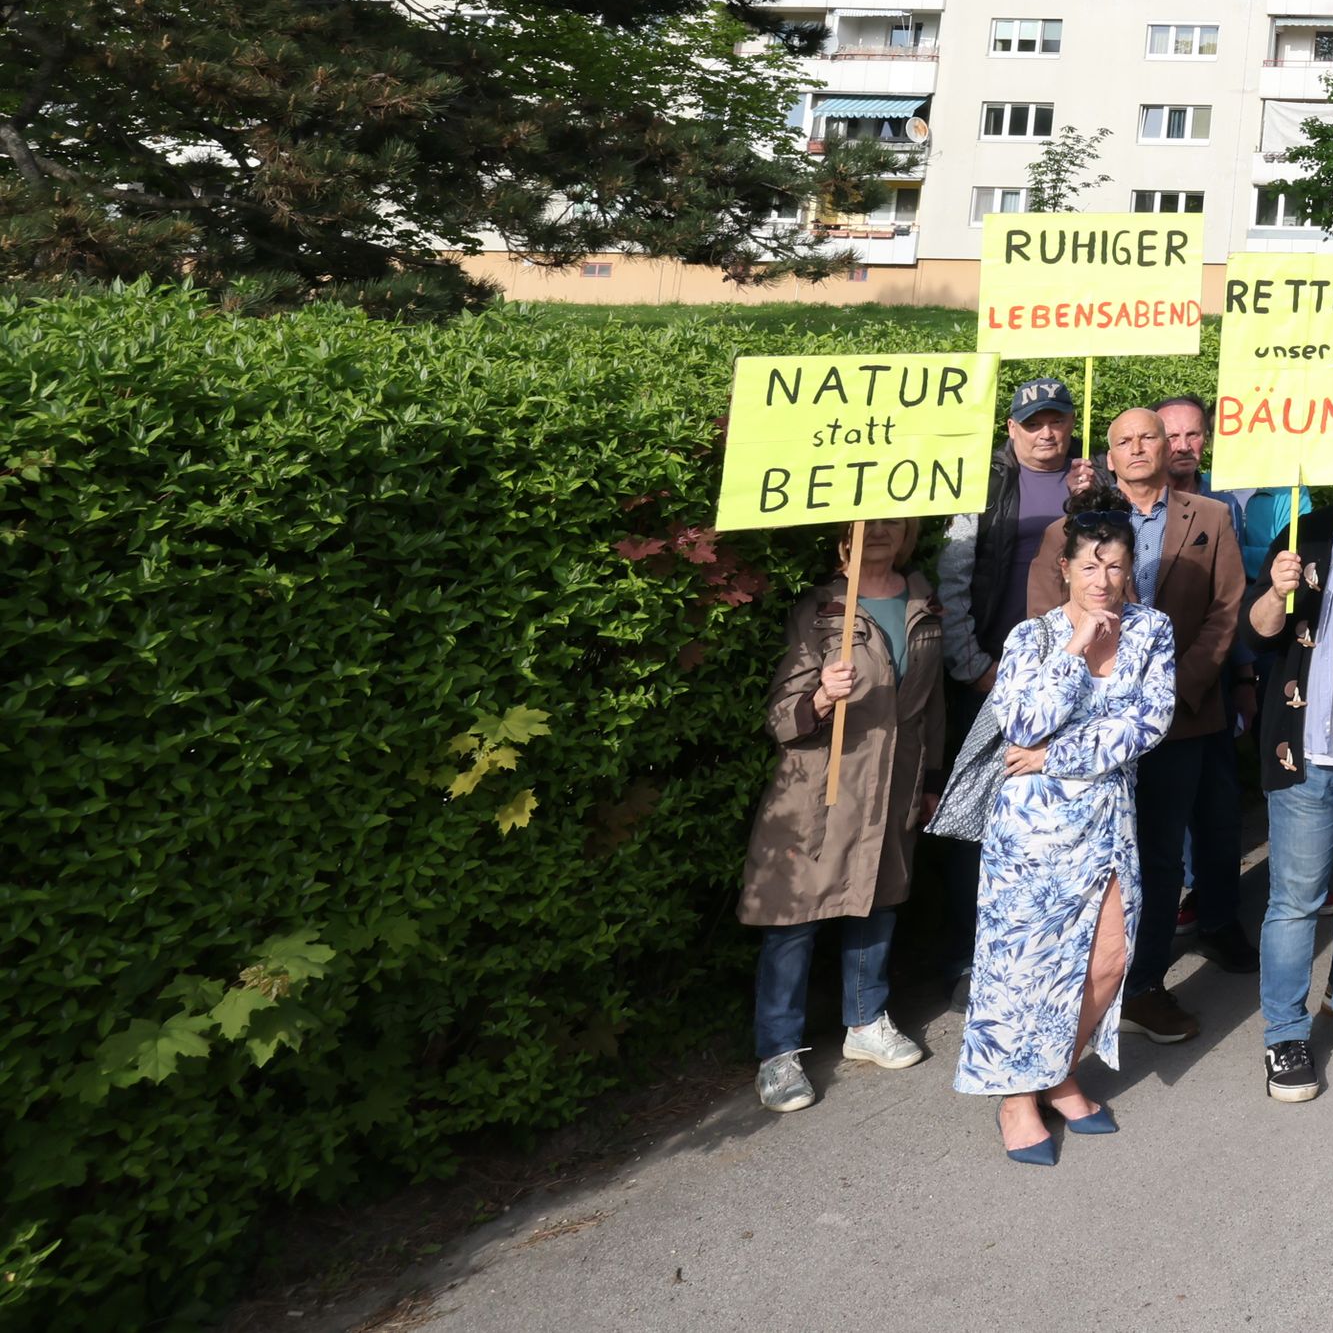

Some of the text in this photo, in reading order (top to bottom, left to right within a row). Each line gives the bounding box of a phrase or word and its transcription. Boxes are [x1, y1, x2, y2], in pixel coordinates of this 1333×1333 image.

[1005, 229, 1189, 266] RUHIGER
[988, 299, 1202, 330] LEBENSABEND
[767, 365, 968, 408] NATUR
[1021, 383, 1060, 405] NY
[813, 421, 896, 449] statt
[760, 457, 963, 514] BETON
